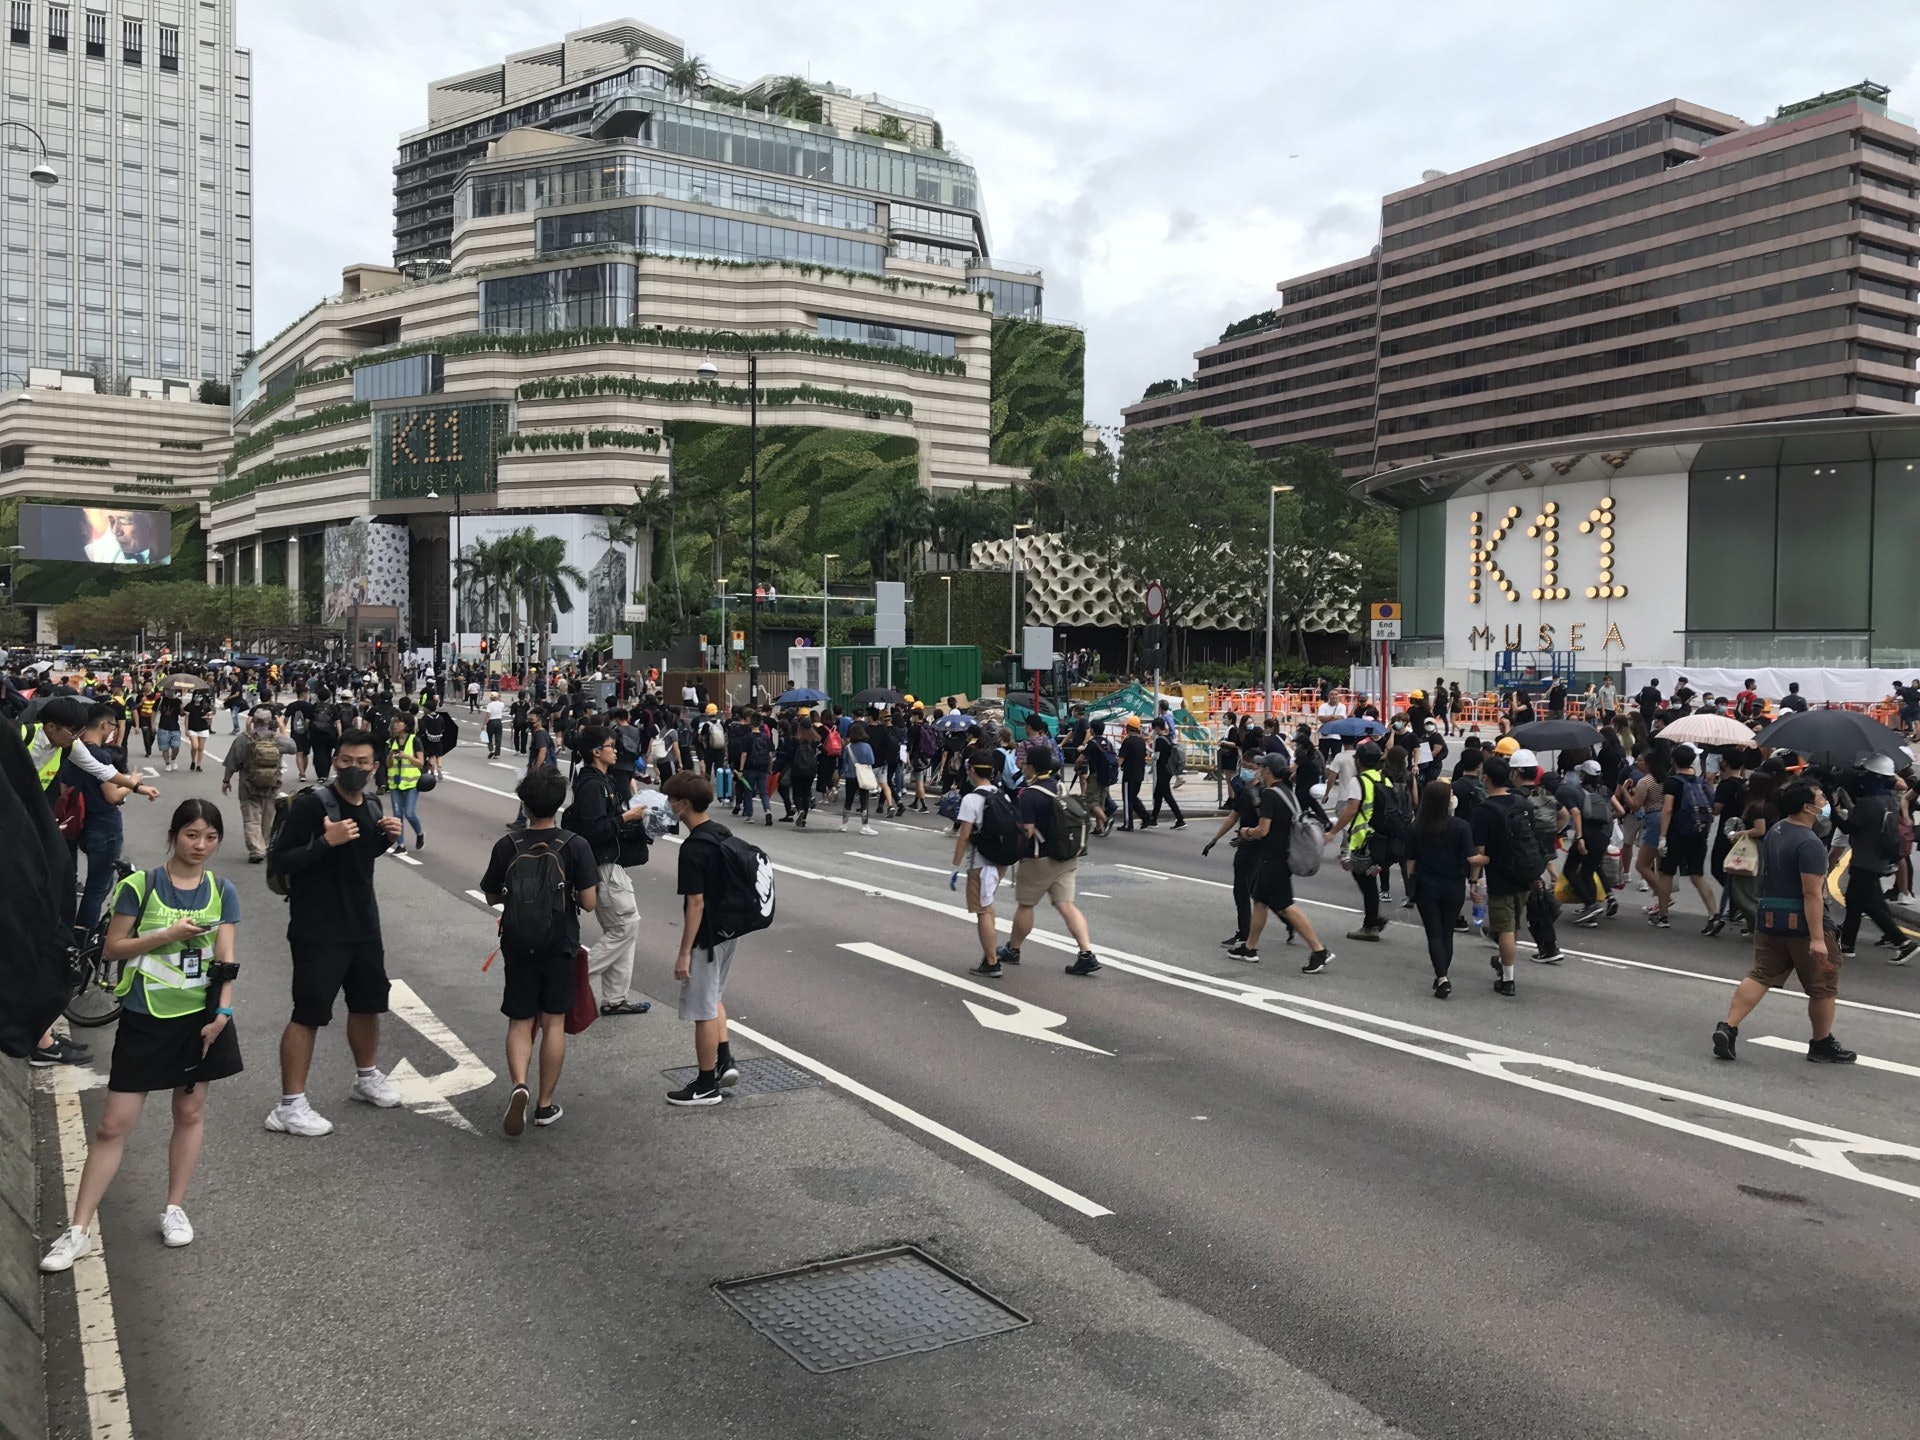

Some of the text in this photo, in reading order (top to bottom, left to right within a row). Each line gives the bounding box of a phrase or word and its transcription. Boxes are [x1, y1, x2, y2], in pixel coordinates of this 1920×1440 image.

[391, 409, 464, 466] K11
[393, 473, 464, 491] MUSEA
[1469, 496, 1629, 604] K11
[1470, 621, 1626, 652] MUSEA
